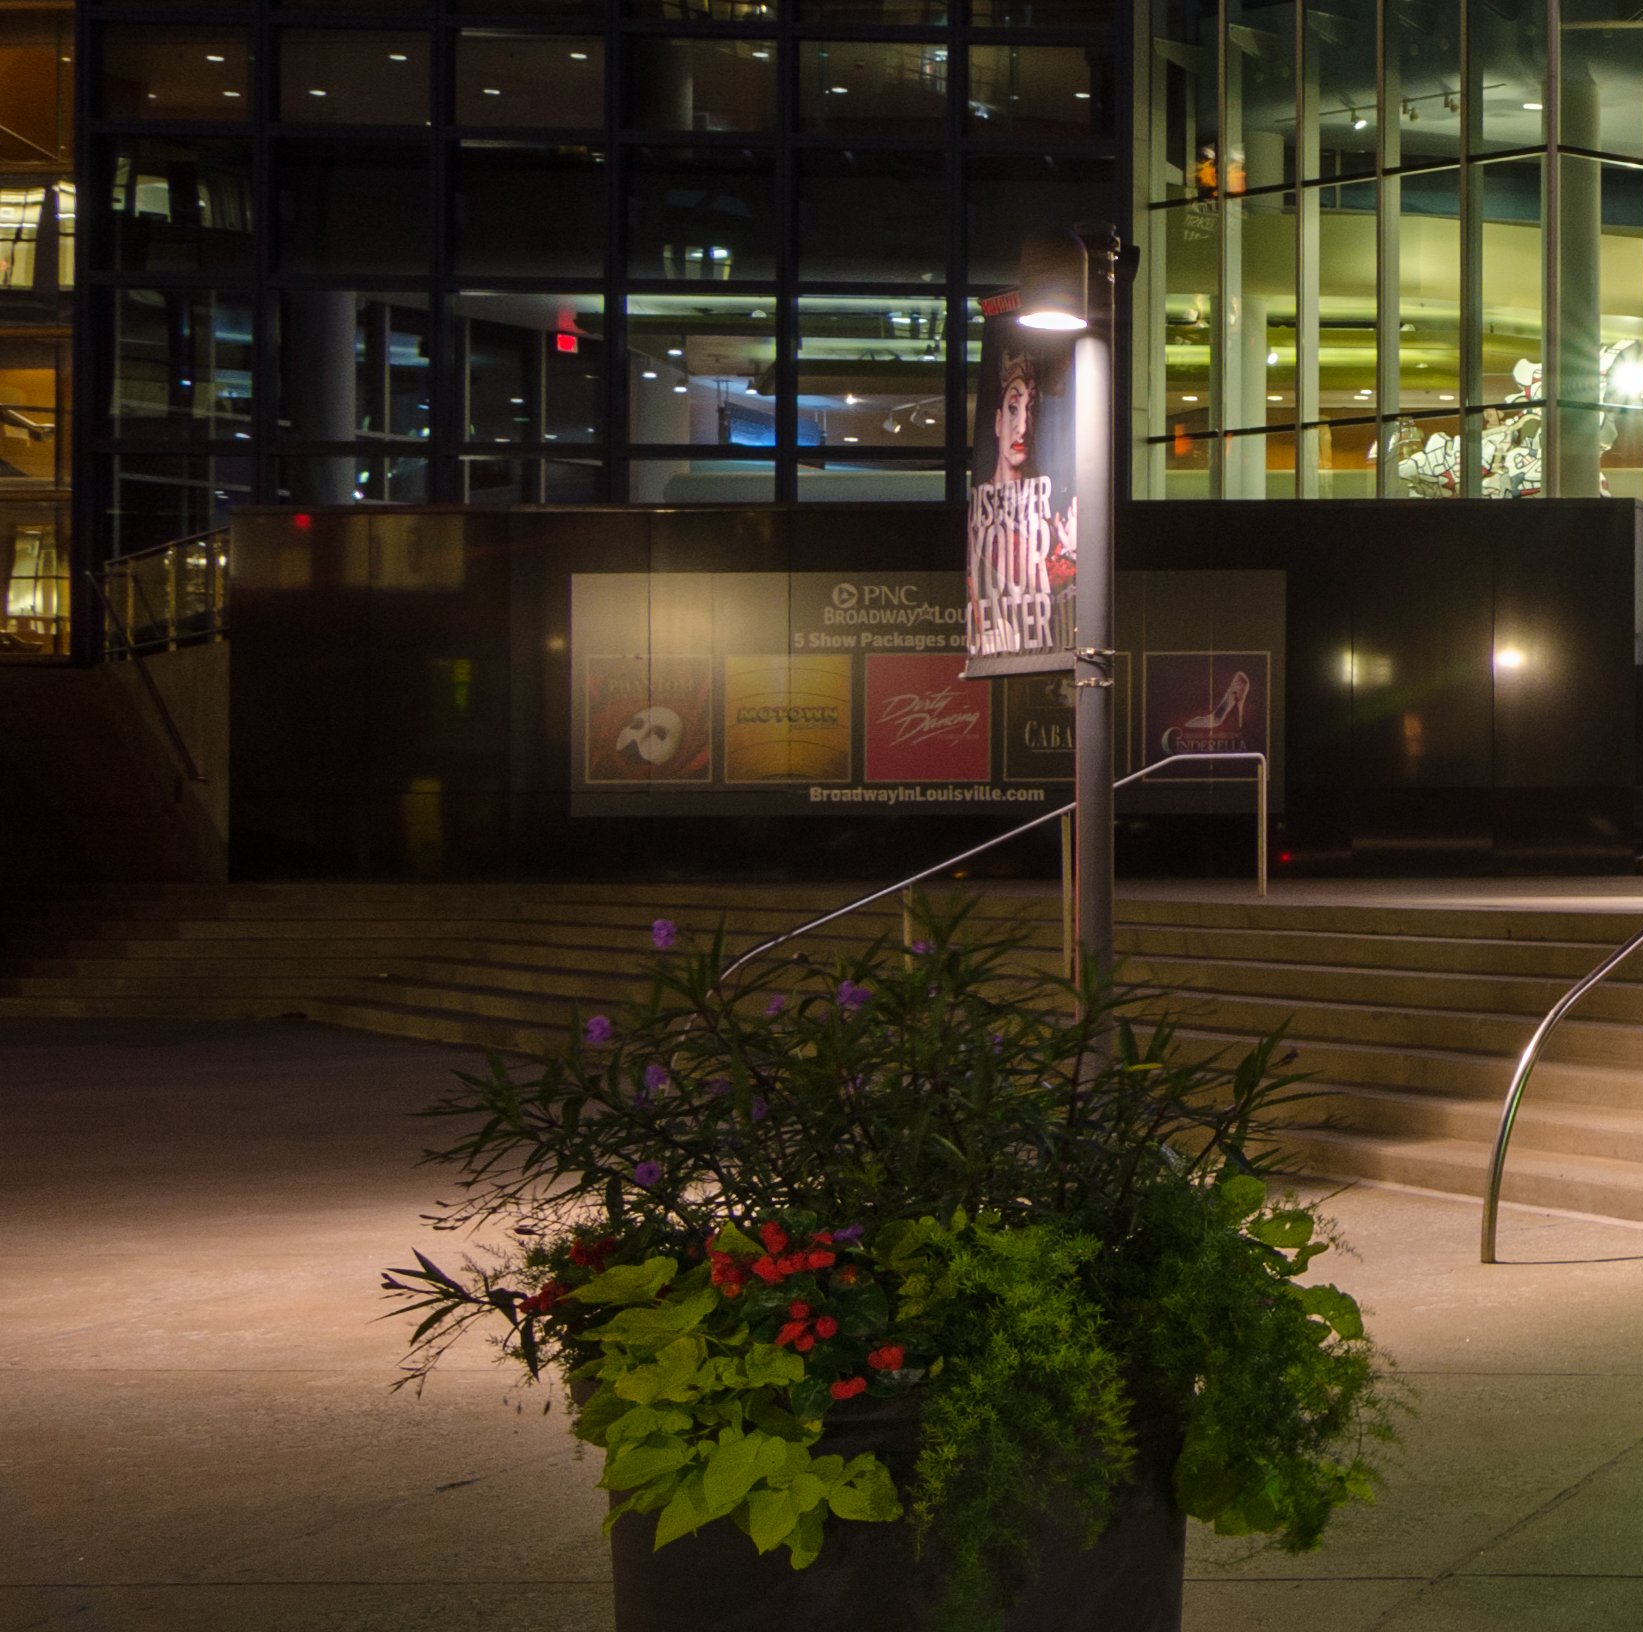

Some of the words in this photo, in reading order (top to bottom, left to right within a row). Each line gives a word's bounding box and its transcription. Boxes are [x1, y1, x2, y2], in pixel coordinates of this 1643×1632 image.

[971, 475, 1051, 528] DISCOVER
[969, 517, 1051, 600] YOUR
[864, 585, 917, 605] PNC
[824, 606, 918, 627] BROADWAY
[968, 593, 1053, 656] CENTER
[794, 633, 805, 648] 5
[808, 632, 856, 648] Show
[860, 631, 945, 652] Packages
[876, 688, 956, 721] Dirty
[1025, 721, 1075, 751] CABA
[810, 786, 1045, 804] BroadwayInLouisville.com
